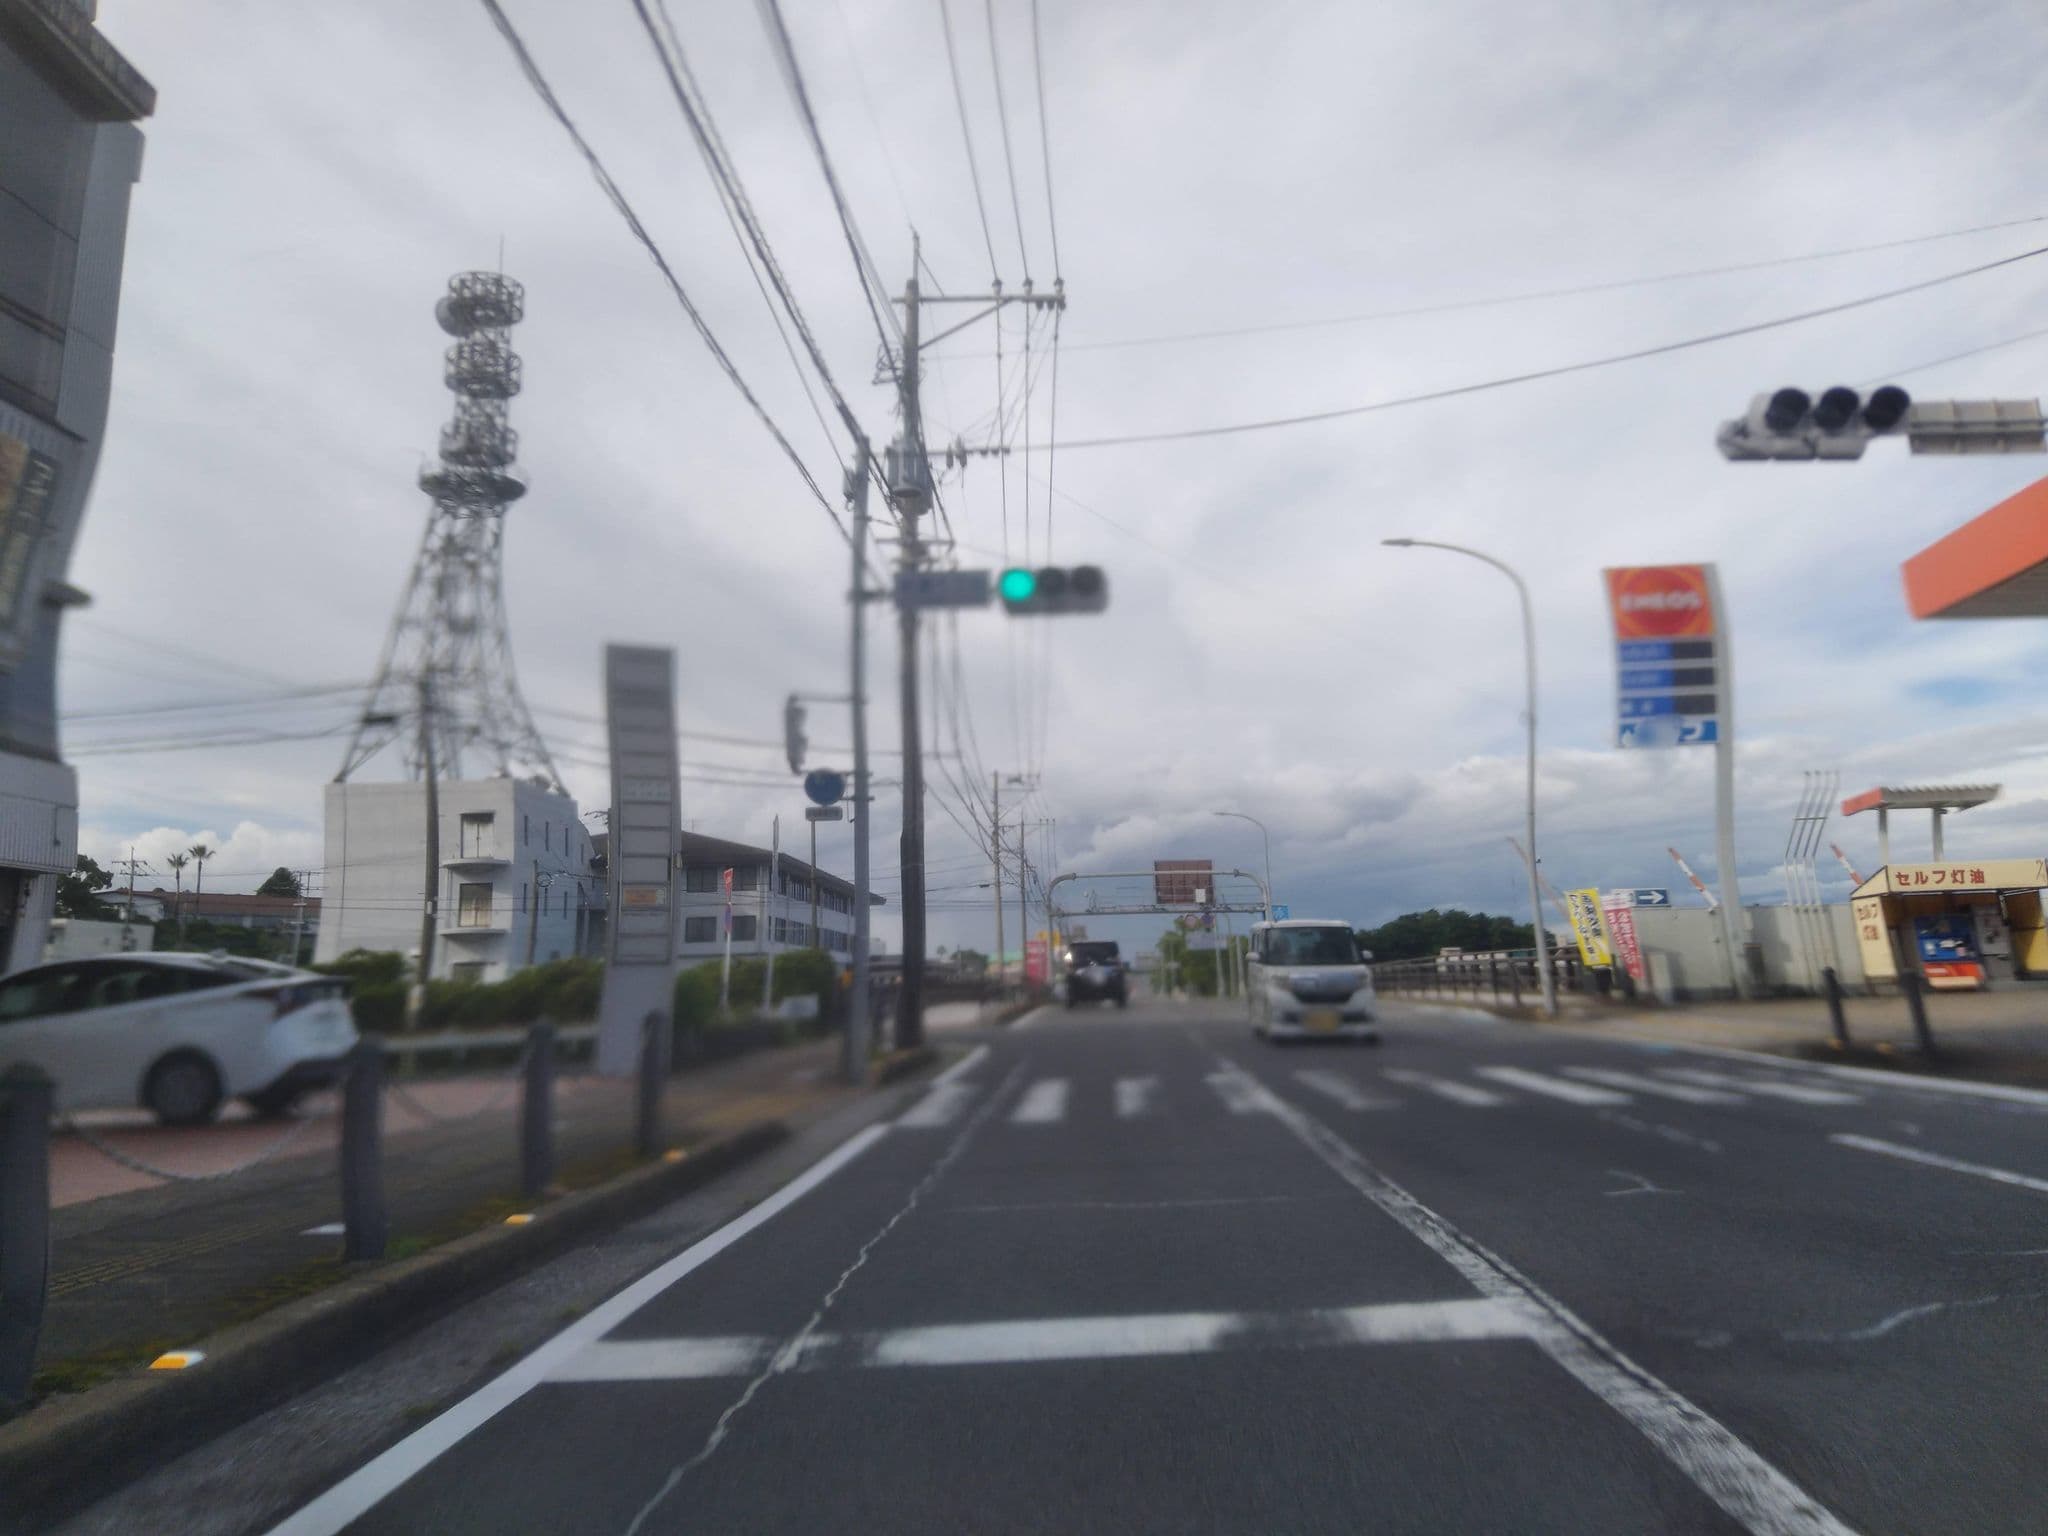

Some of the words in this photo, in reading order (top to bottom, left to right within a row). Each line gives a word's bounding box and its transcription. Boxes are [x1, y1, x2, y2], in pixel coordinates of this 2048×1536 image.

[1895, 868, 1985, 886] セルフ灯油
